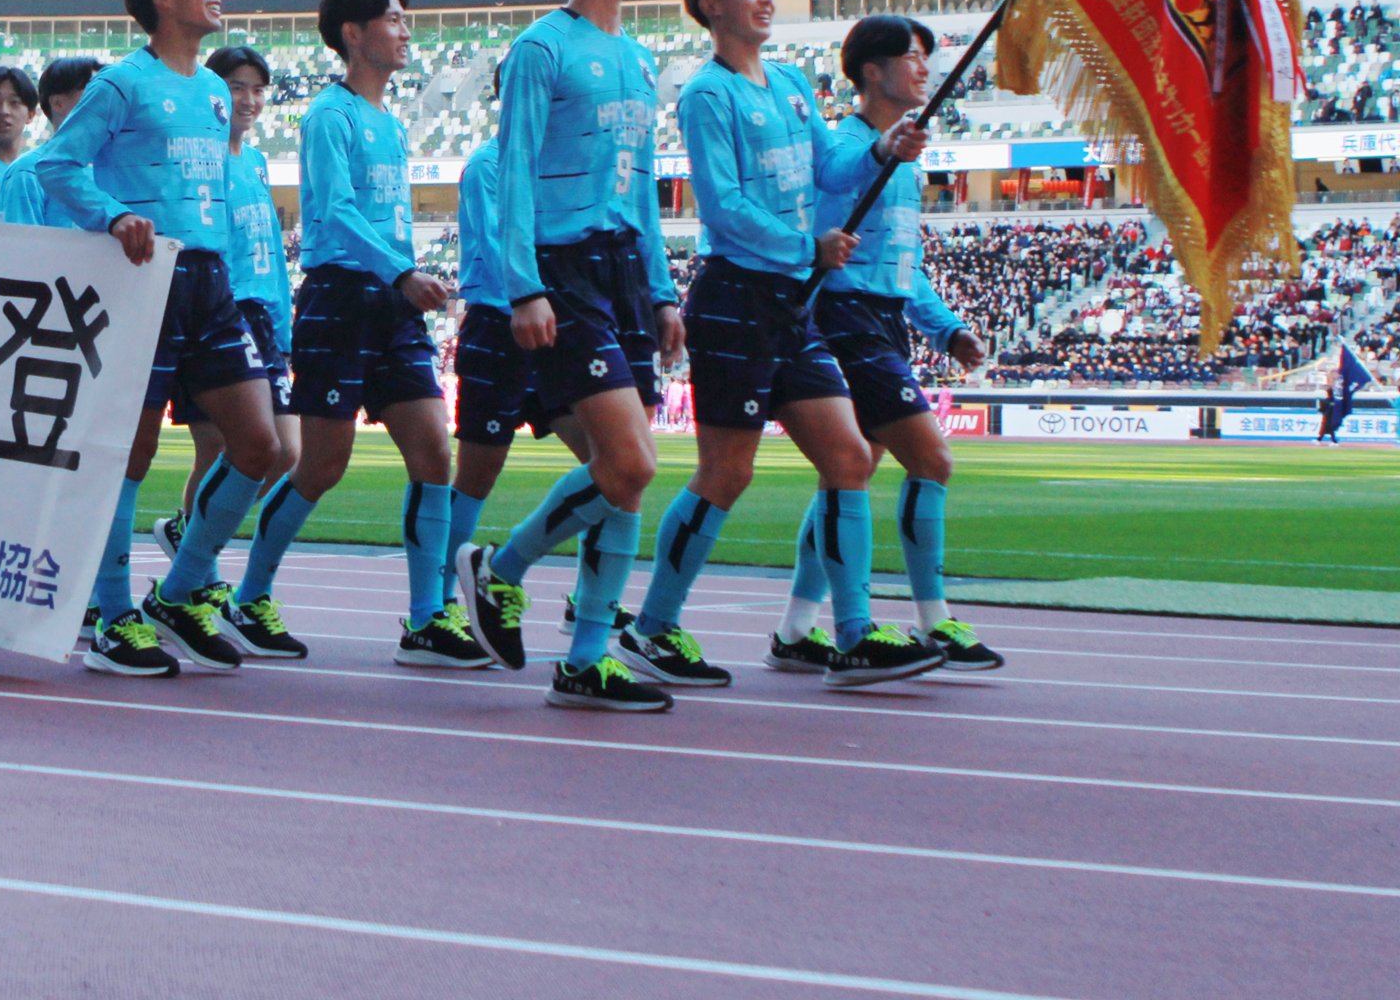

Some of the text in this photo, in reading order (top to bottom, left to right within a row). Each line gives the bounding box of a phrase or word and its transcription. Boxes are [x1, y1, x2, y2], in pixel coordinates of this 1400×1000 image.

[1341, 133, 1400, 152] 兵庫代
[615, 150, 633, 194] 9
[197, 184, 213, 225] 2
[1071, 416, 1149, 433] TOYOTA
